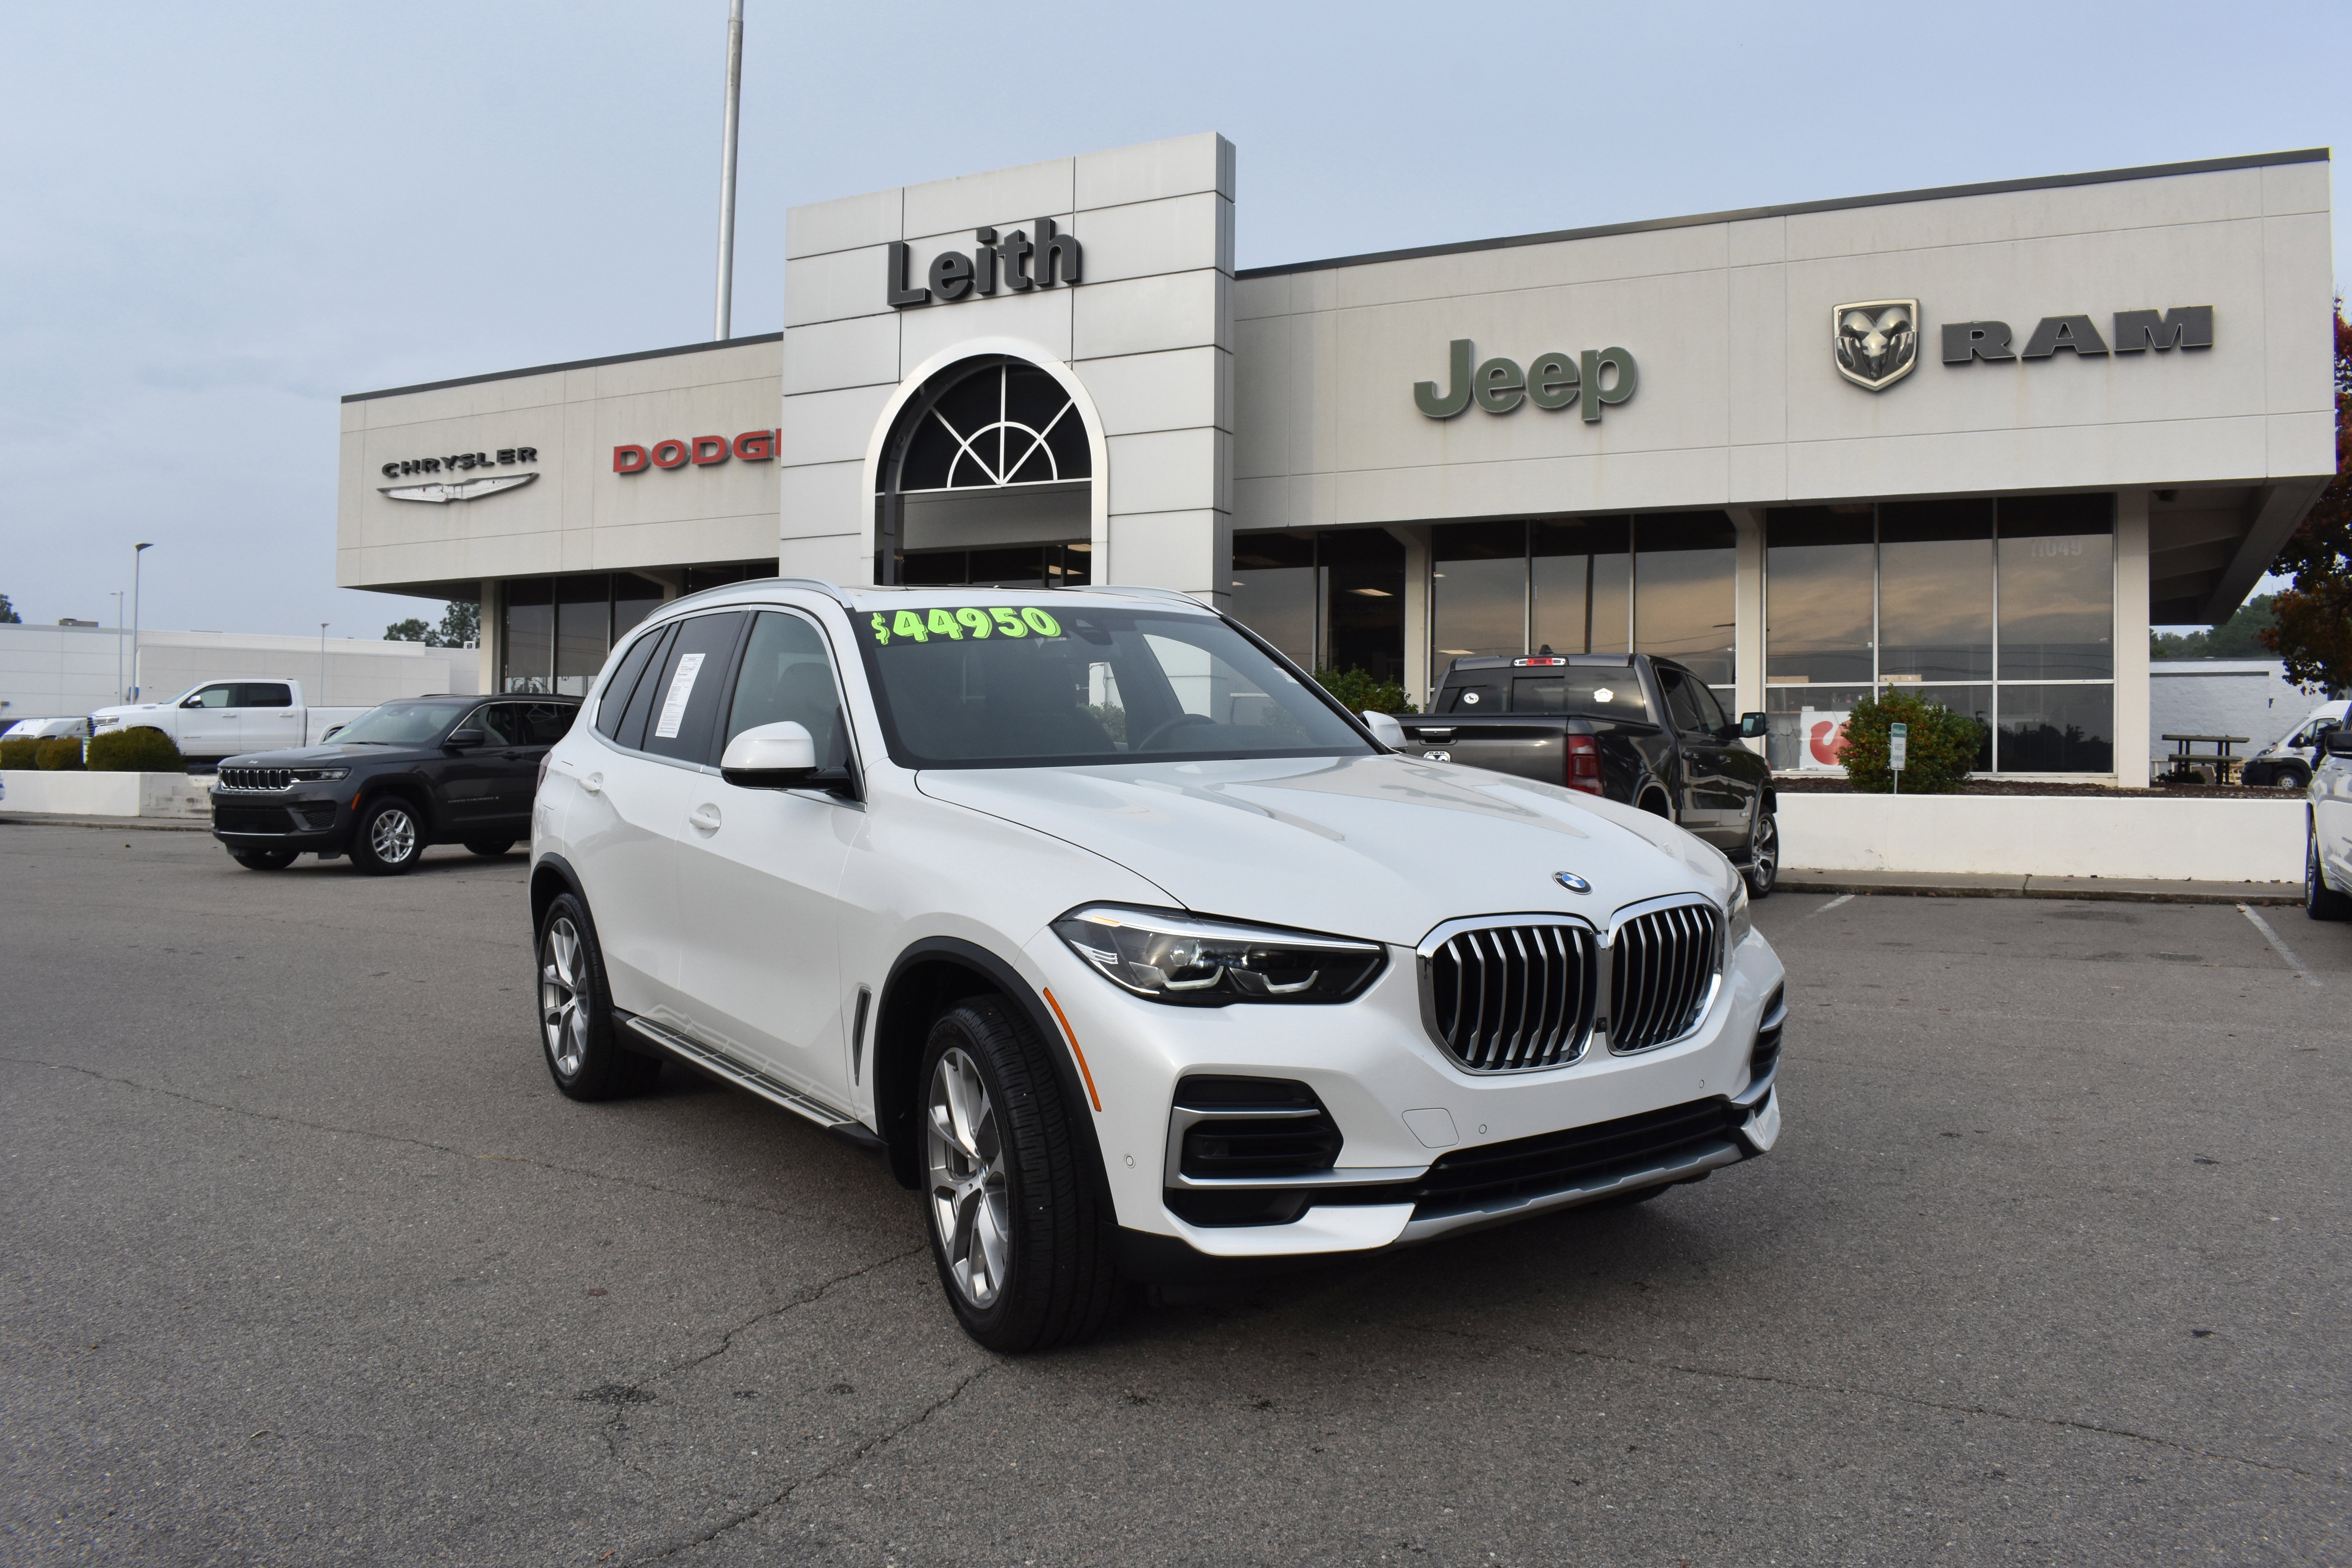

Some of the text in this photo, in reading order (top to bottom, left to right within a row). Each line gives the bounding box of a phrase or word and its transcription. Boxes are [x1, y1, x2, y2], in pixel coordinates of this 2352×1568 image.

[887, 217, 1082, 308] Leith
[1942, 305, 2213, 364] RAM
[1414, 339, 1638, 422] Jeep
[382, 447, 537, 478] CHRYSLER
[613, 428, 782, 474] DODG
[871, 608, 1061, 645] $44950
